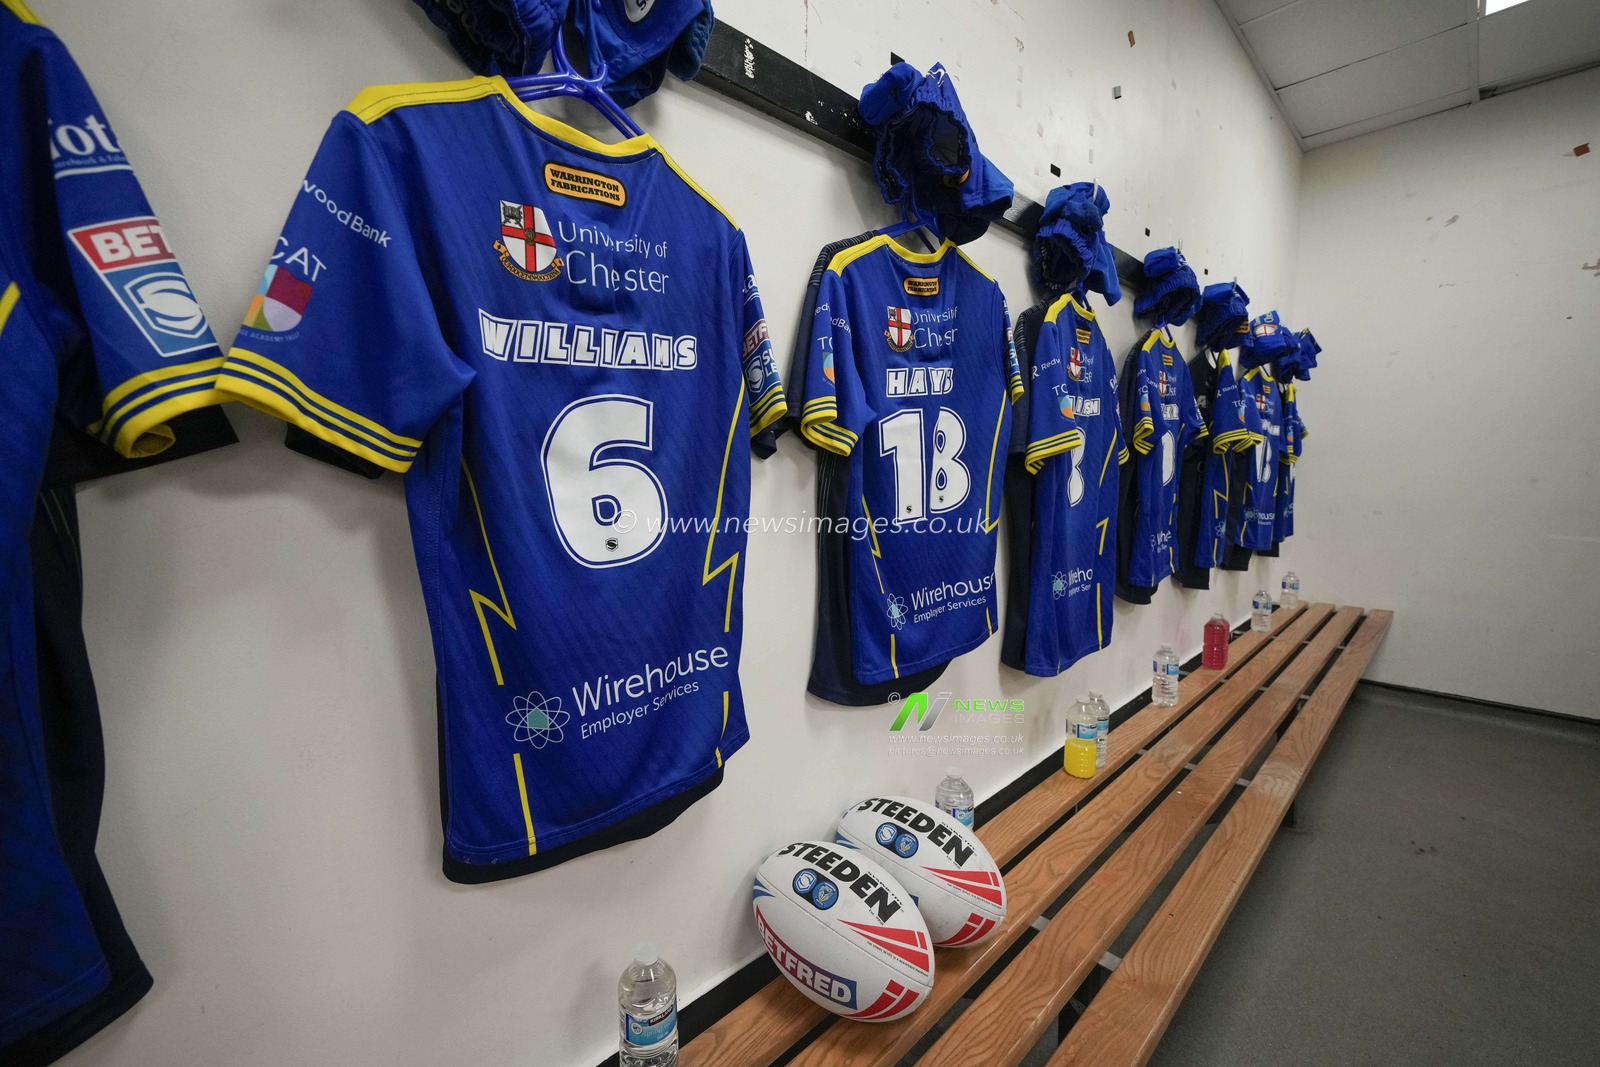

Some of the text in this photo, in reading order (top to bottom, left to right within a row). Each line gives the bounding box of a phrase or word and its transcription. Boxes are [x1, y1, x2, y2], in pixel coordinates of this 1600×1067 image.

[549, 168, 619, 192] WARRINGTON
[550, 179, 621, 201] FABRICATIONS
[558, 221, 667, 259] Univrsity of
[478, 308, 698, 371] WILLIAMS
[540, 393, 669, 569] 6
[914, 596, 987, 624] Employer Services
[572, 646, 729, 718] Wirehouse
[581, 681, 700, 740] Employer Services
[857, 797, 976, 868] STEEDEN
[778, 842, 902, 924] STEEDEN
[757, 920, 852, 1004] BETFRED
